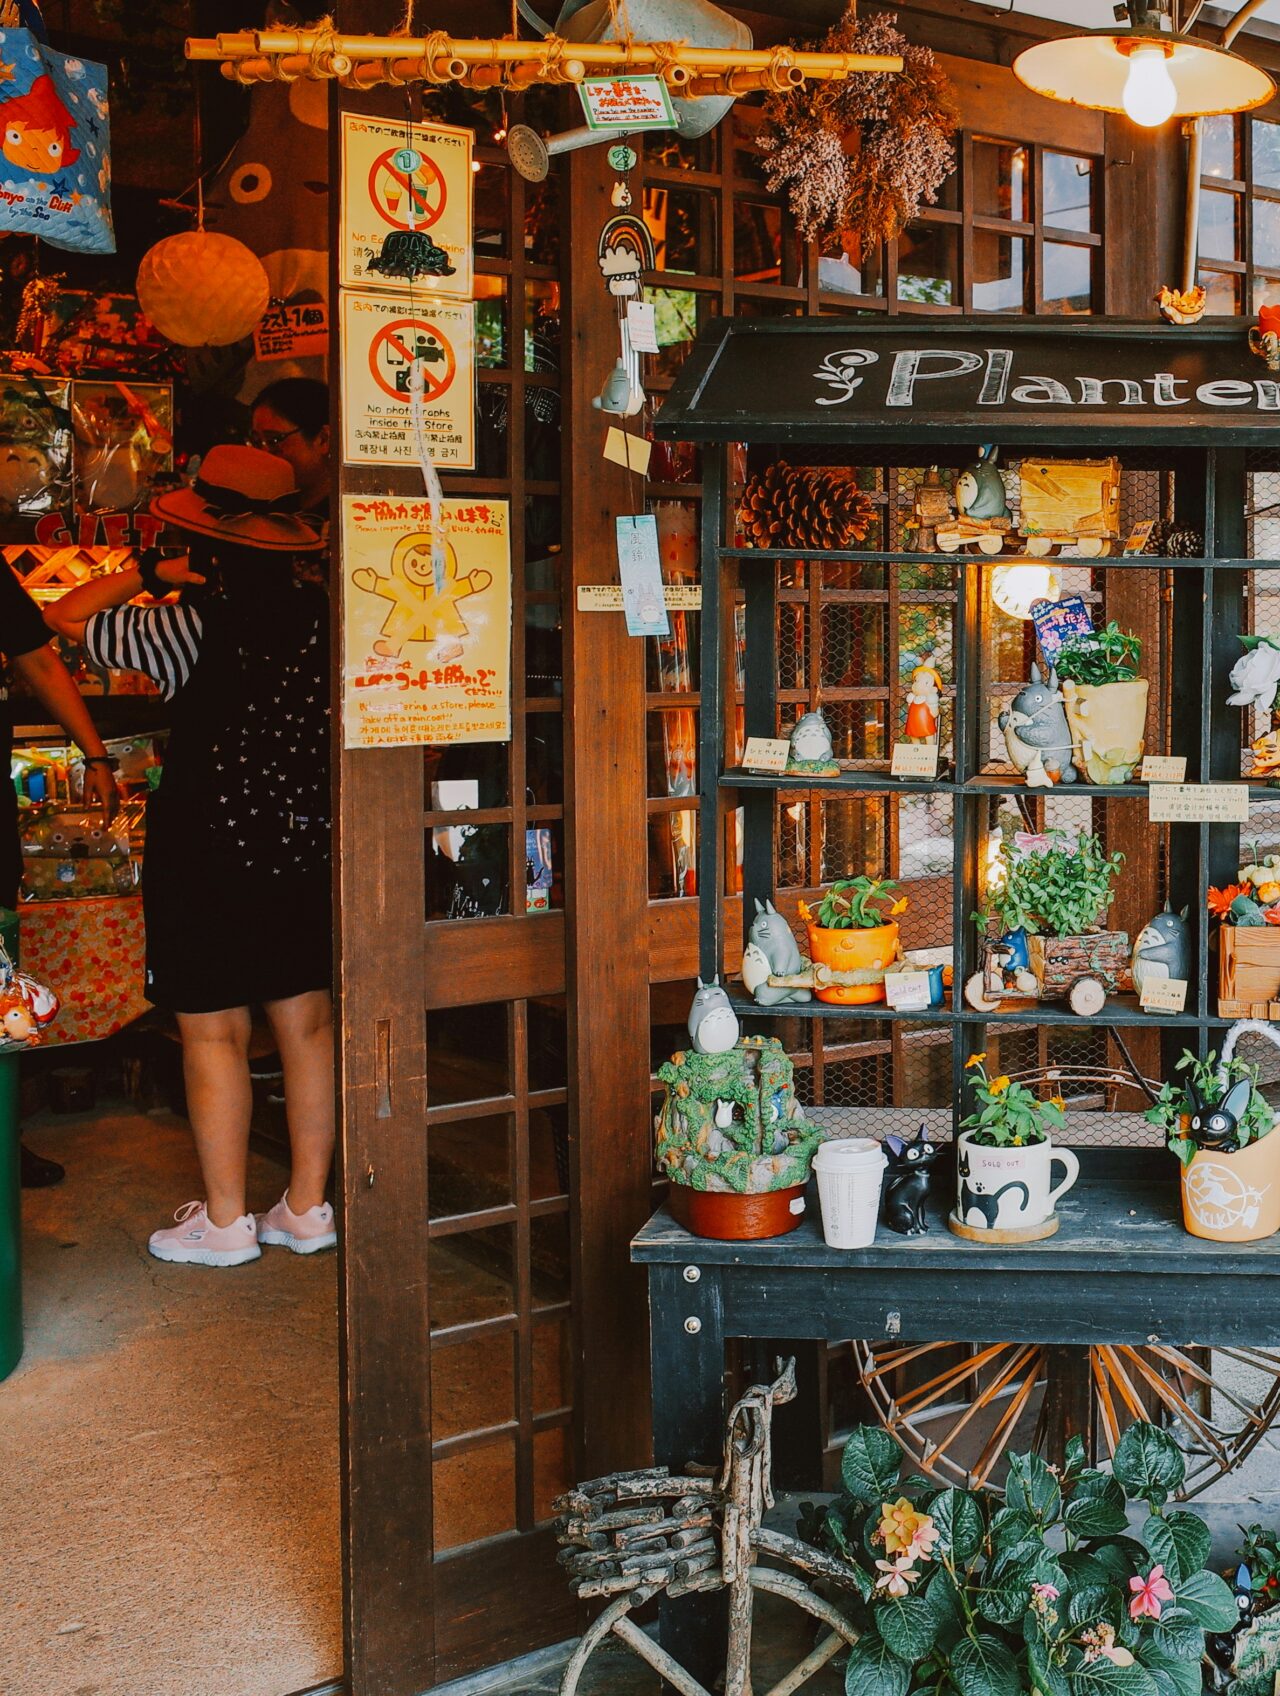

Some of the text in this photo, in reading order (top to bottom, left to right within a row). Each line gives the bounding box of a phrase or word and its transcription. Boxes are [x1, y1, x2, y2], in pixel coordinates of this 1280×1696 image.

[49, 195, 73, 213] Cliff
[33, 206, 50, 220] Sea
[352, 232, 366, 242] No
[368, 404, 381, 414] No
[370, 418, 453, 430] inside th Store
[360, 444, 388, 455] 매장내
[393, 446, 412, 456] 사진
[440, 447, 458, 458] 금지
[982, 1160, 1000, 1168] SOLD
